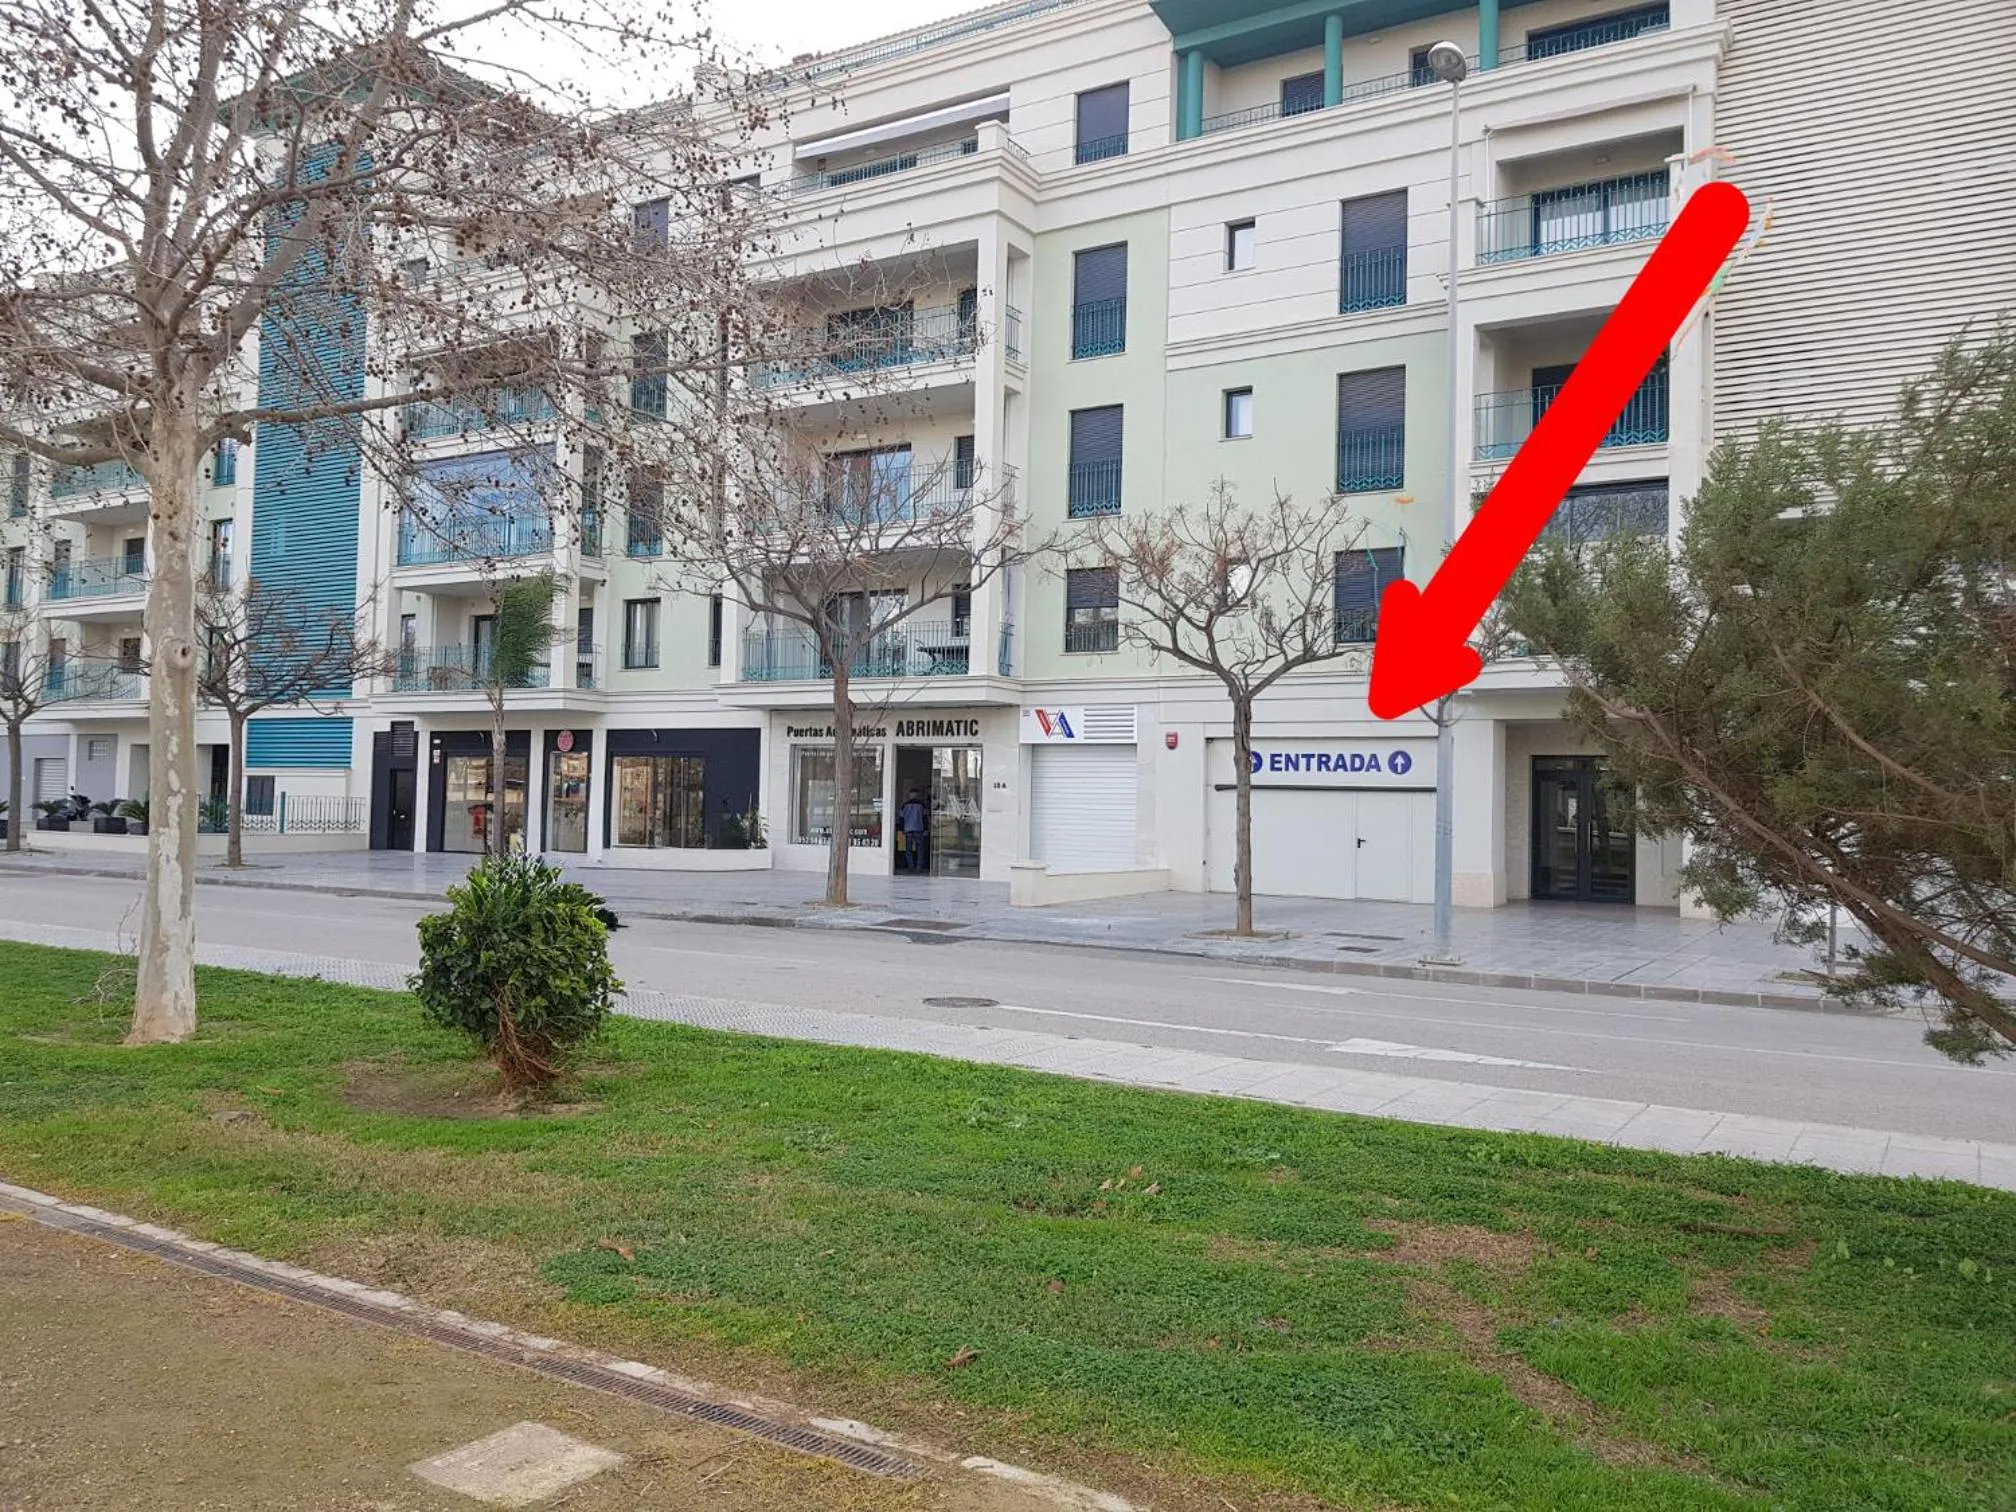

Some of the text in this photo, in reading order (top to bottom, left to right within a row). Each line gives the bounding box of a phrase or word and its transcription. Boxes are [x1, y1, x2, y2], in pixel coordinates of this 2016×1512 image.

[786, 725, 824, 738] Puertas
[895, 719, 979, 738] ABRIMATIC
[1269, 753, 1382, 772] ENTRADA
